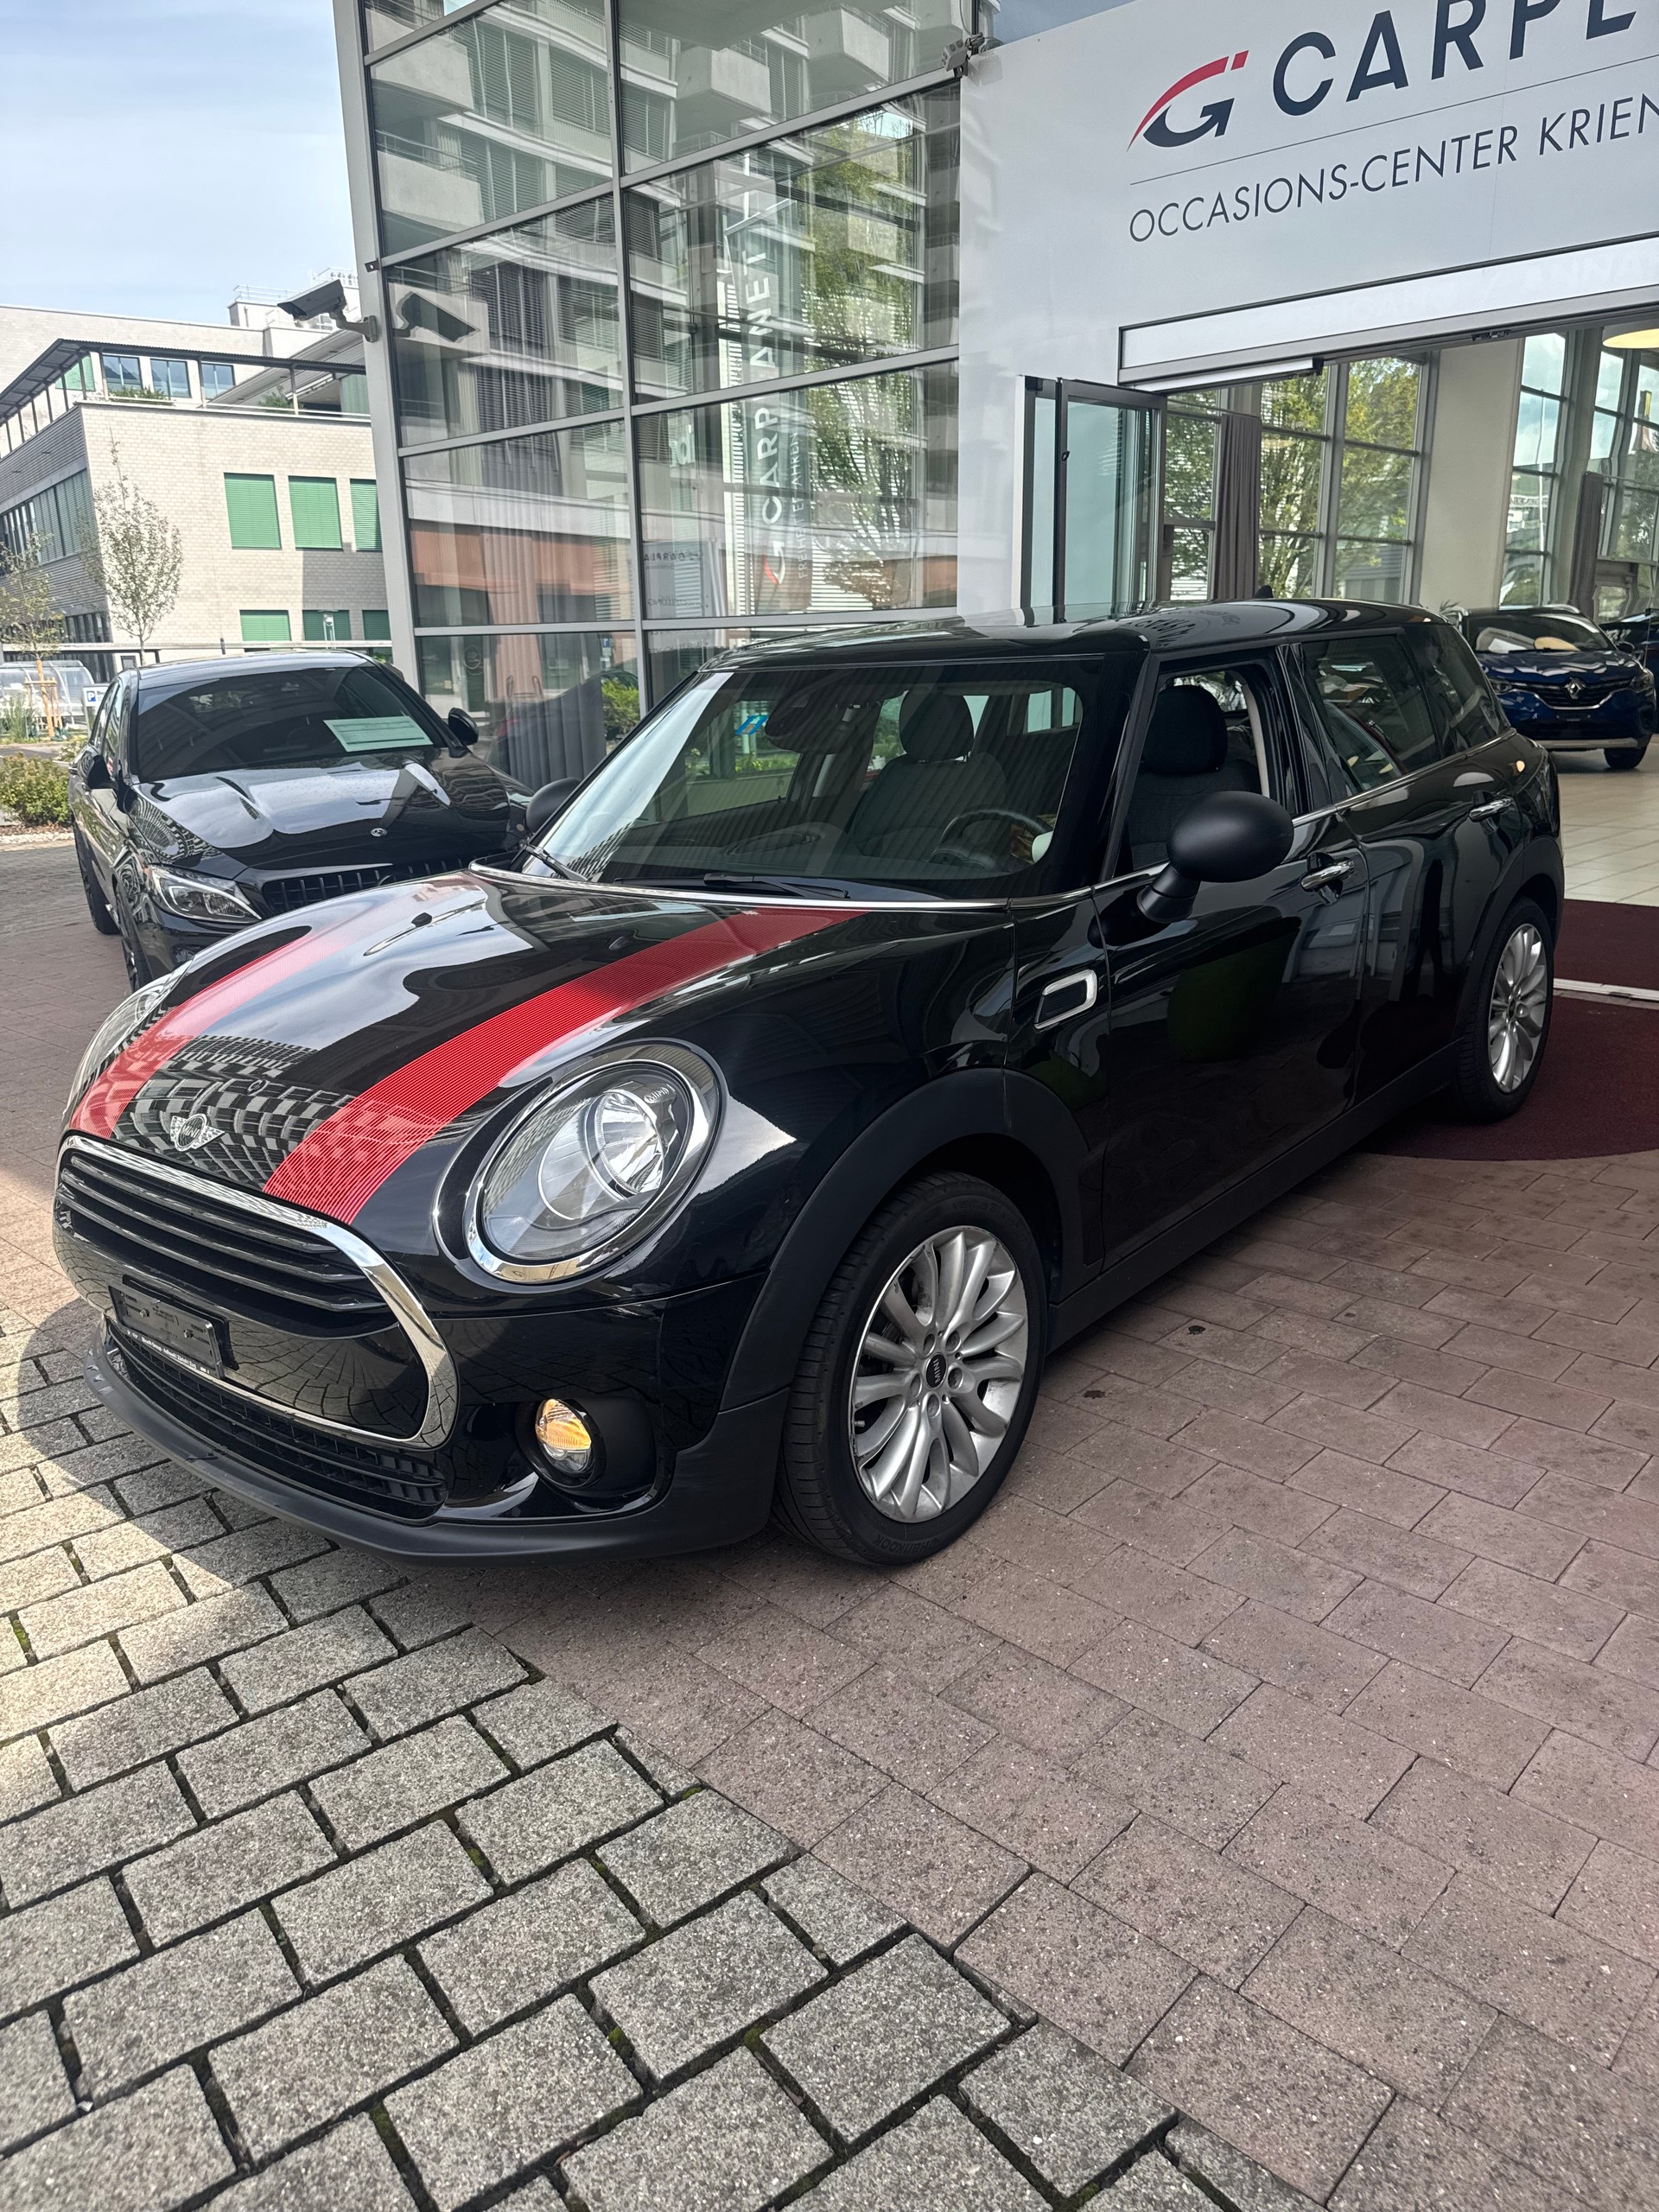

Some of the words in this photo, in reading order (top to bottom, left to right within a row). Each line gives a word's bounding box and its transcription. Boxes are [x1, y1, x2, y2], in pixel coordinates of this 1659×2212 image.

[1129, 125, 1518, 243] OCCASIONS-CENTER
[741, 250, 784, 525] CARPANET
[181, 1124, 200, 1139] MINI
[932, 1357, 942, 1384] MINI
